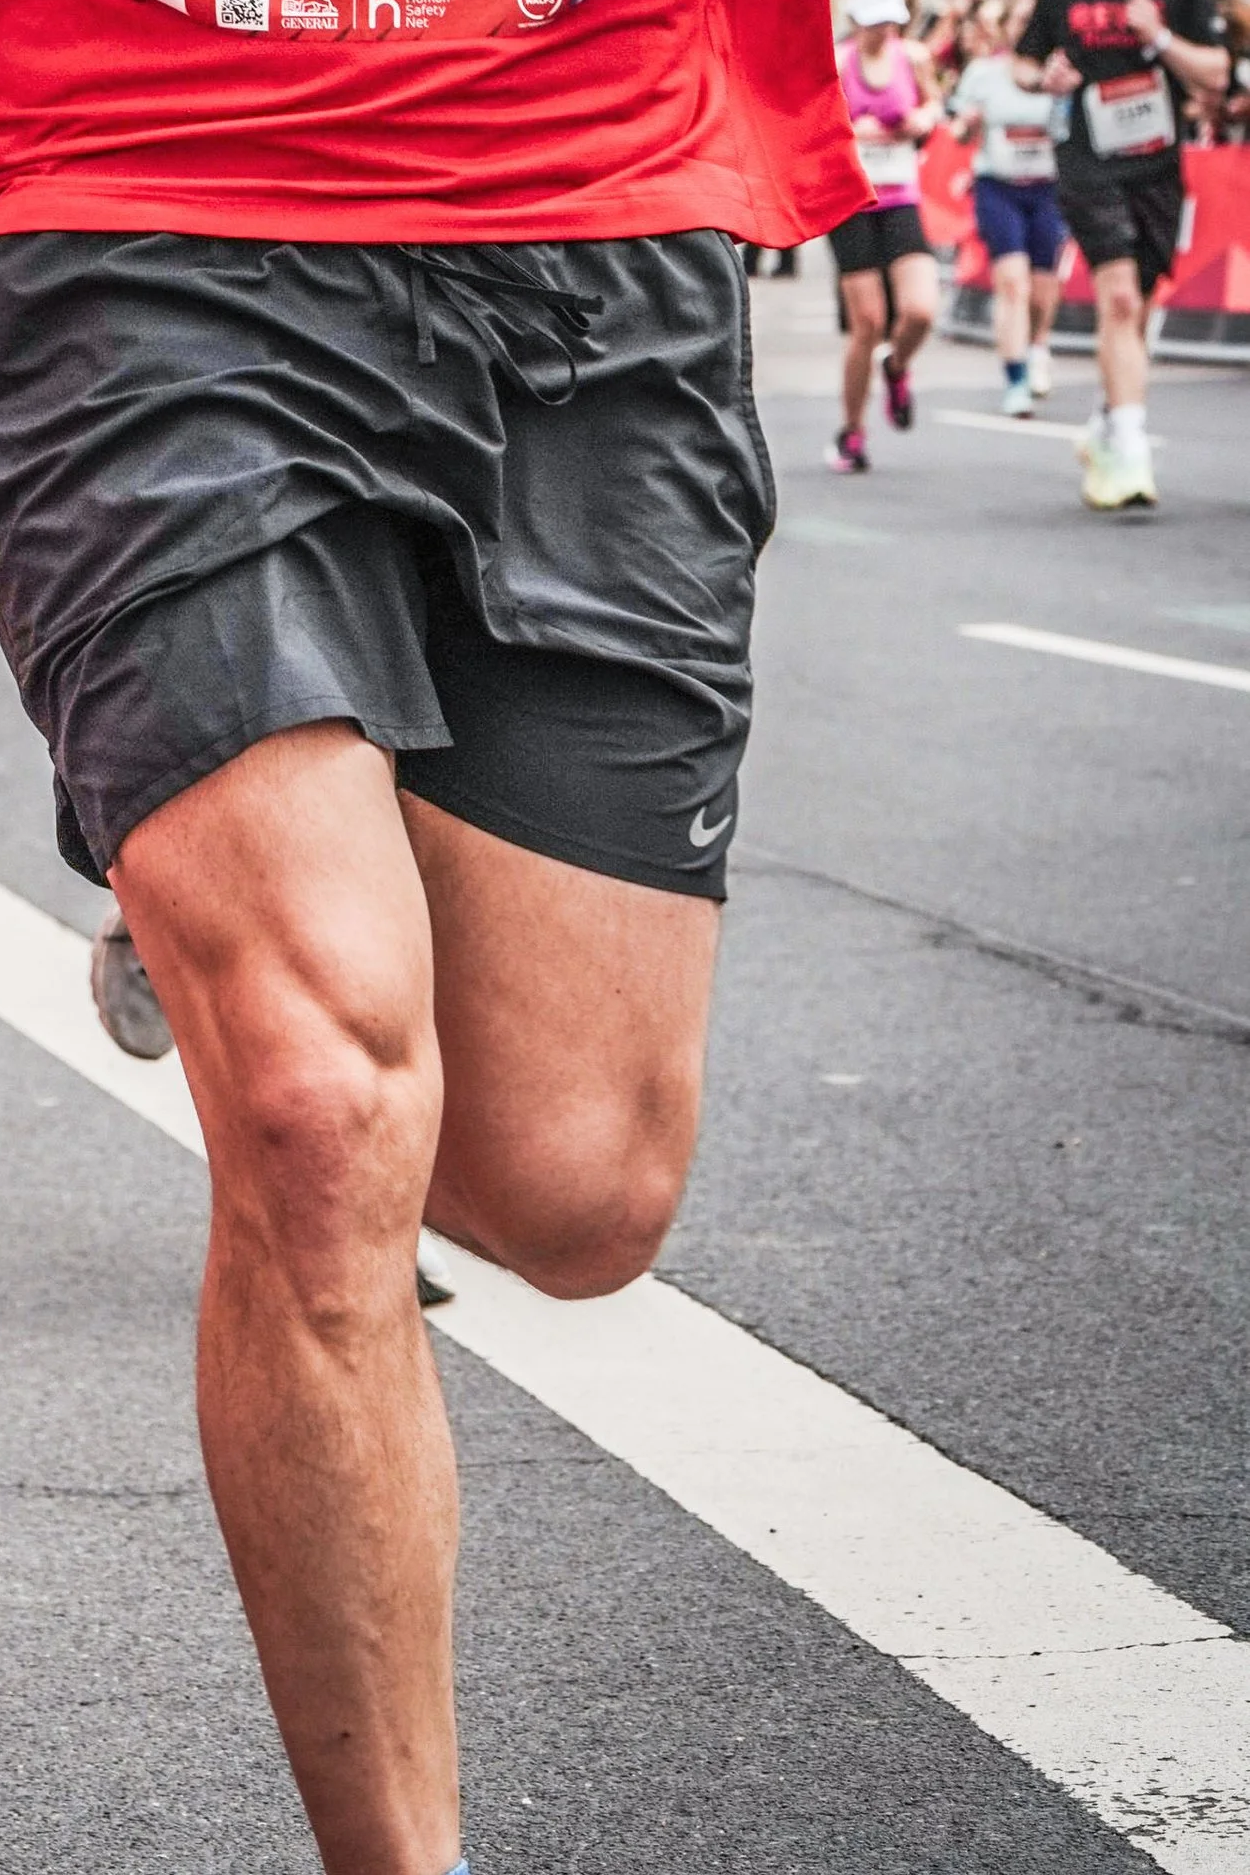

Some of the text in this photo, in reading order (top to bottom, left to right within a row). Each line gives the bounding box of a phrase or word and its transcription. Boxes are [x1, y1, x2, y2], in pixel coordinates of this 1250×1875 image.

[405, 4, 447, 18] Safety
[281, 17, 339, 30] GENERALI
[405, 17, 430, 29] Net
